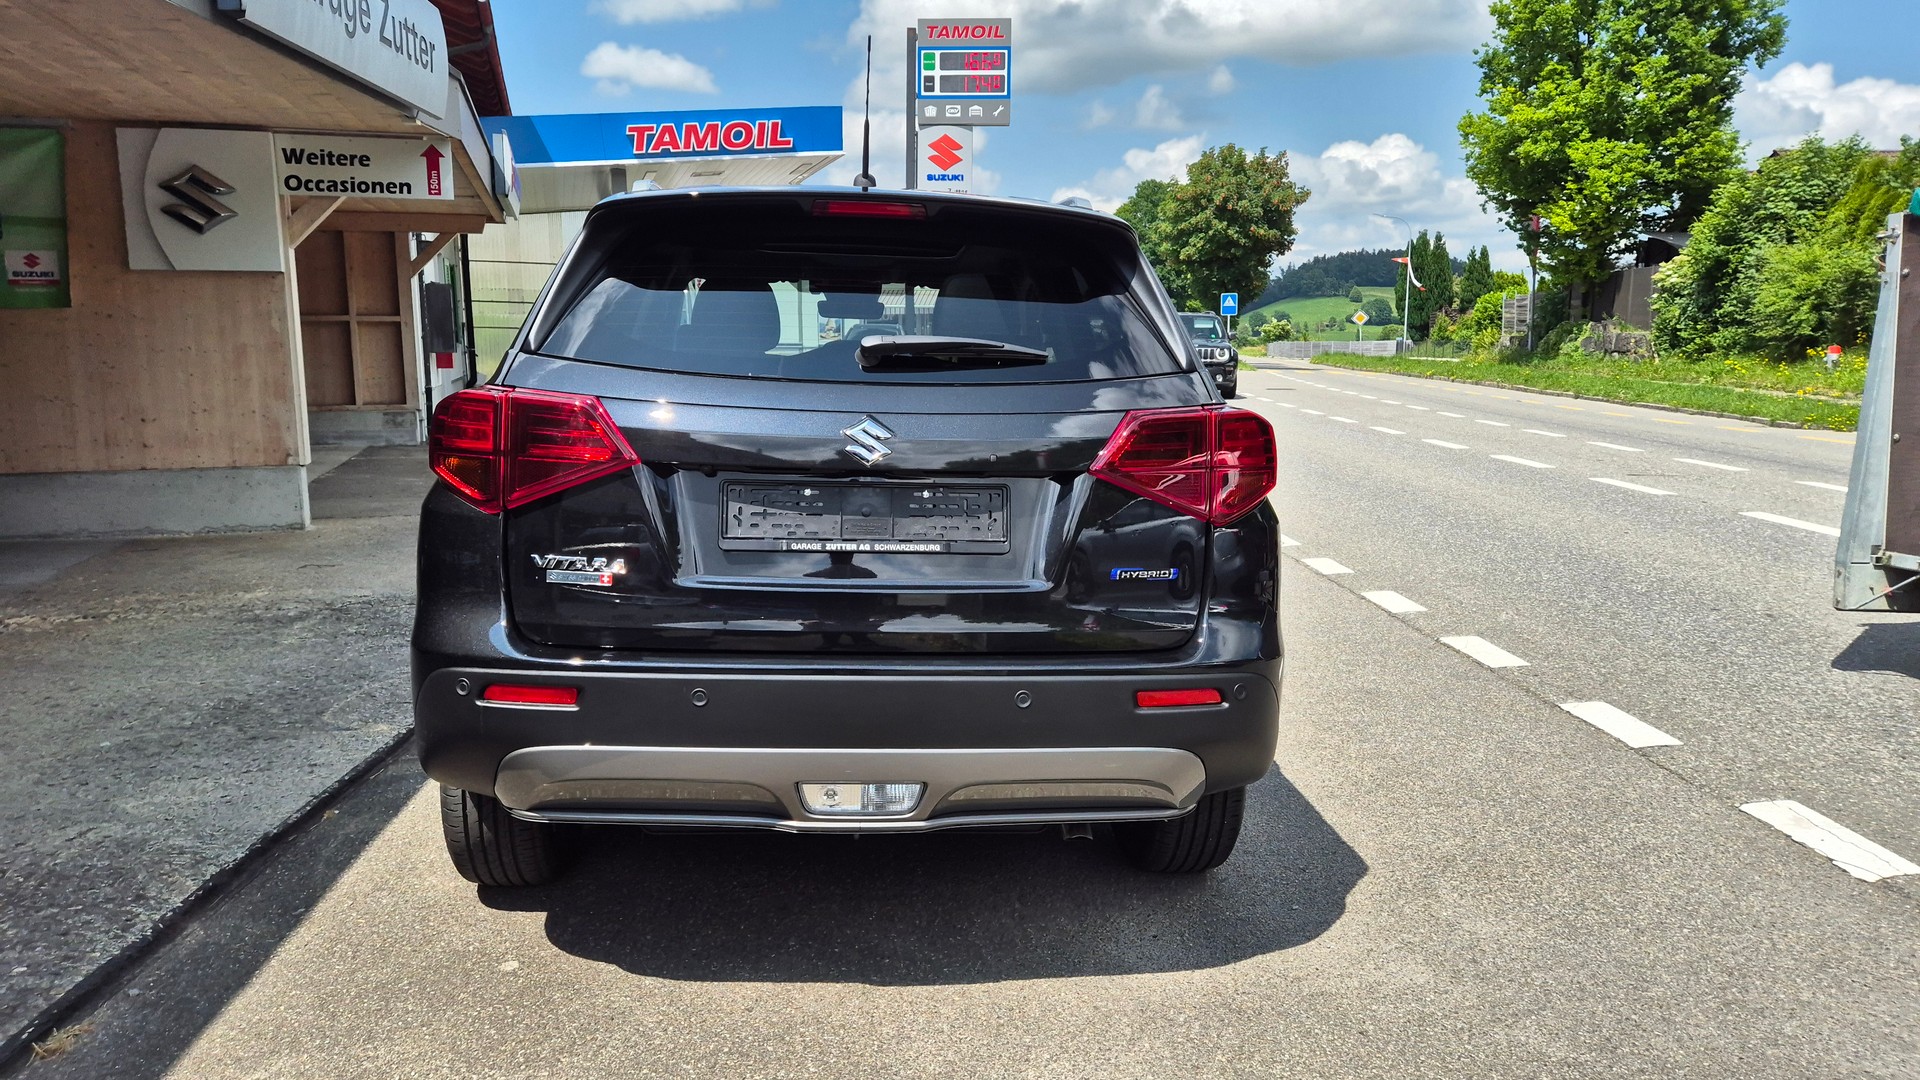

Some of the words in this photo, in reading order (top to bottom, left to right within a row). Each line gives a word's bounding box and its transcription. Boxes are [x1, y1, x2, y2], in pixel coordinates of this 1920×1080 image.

[379, 0, 436, 73] Zutter
[926, 25, 1006, 40] TAMOIL
[626, 120, 793, 154] TAMOIL
[281, 147, 371, 168] Weitere
[283, 174, 412, 195] Occasionen
[430, 170, 439, 195] 150m
[791, 542, 822, 551] GARAGE
[825, 542, 857, 551] ZUTTER
[859, 542, 871, 551] AG
[874, 543, 941, 552] SCHWARZENBURG
[531, 554, 626, 574] VITARA
[1121, 570, 1169, 578] HYBRID
